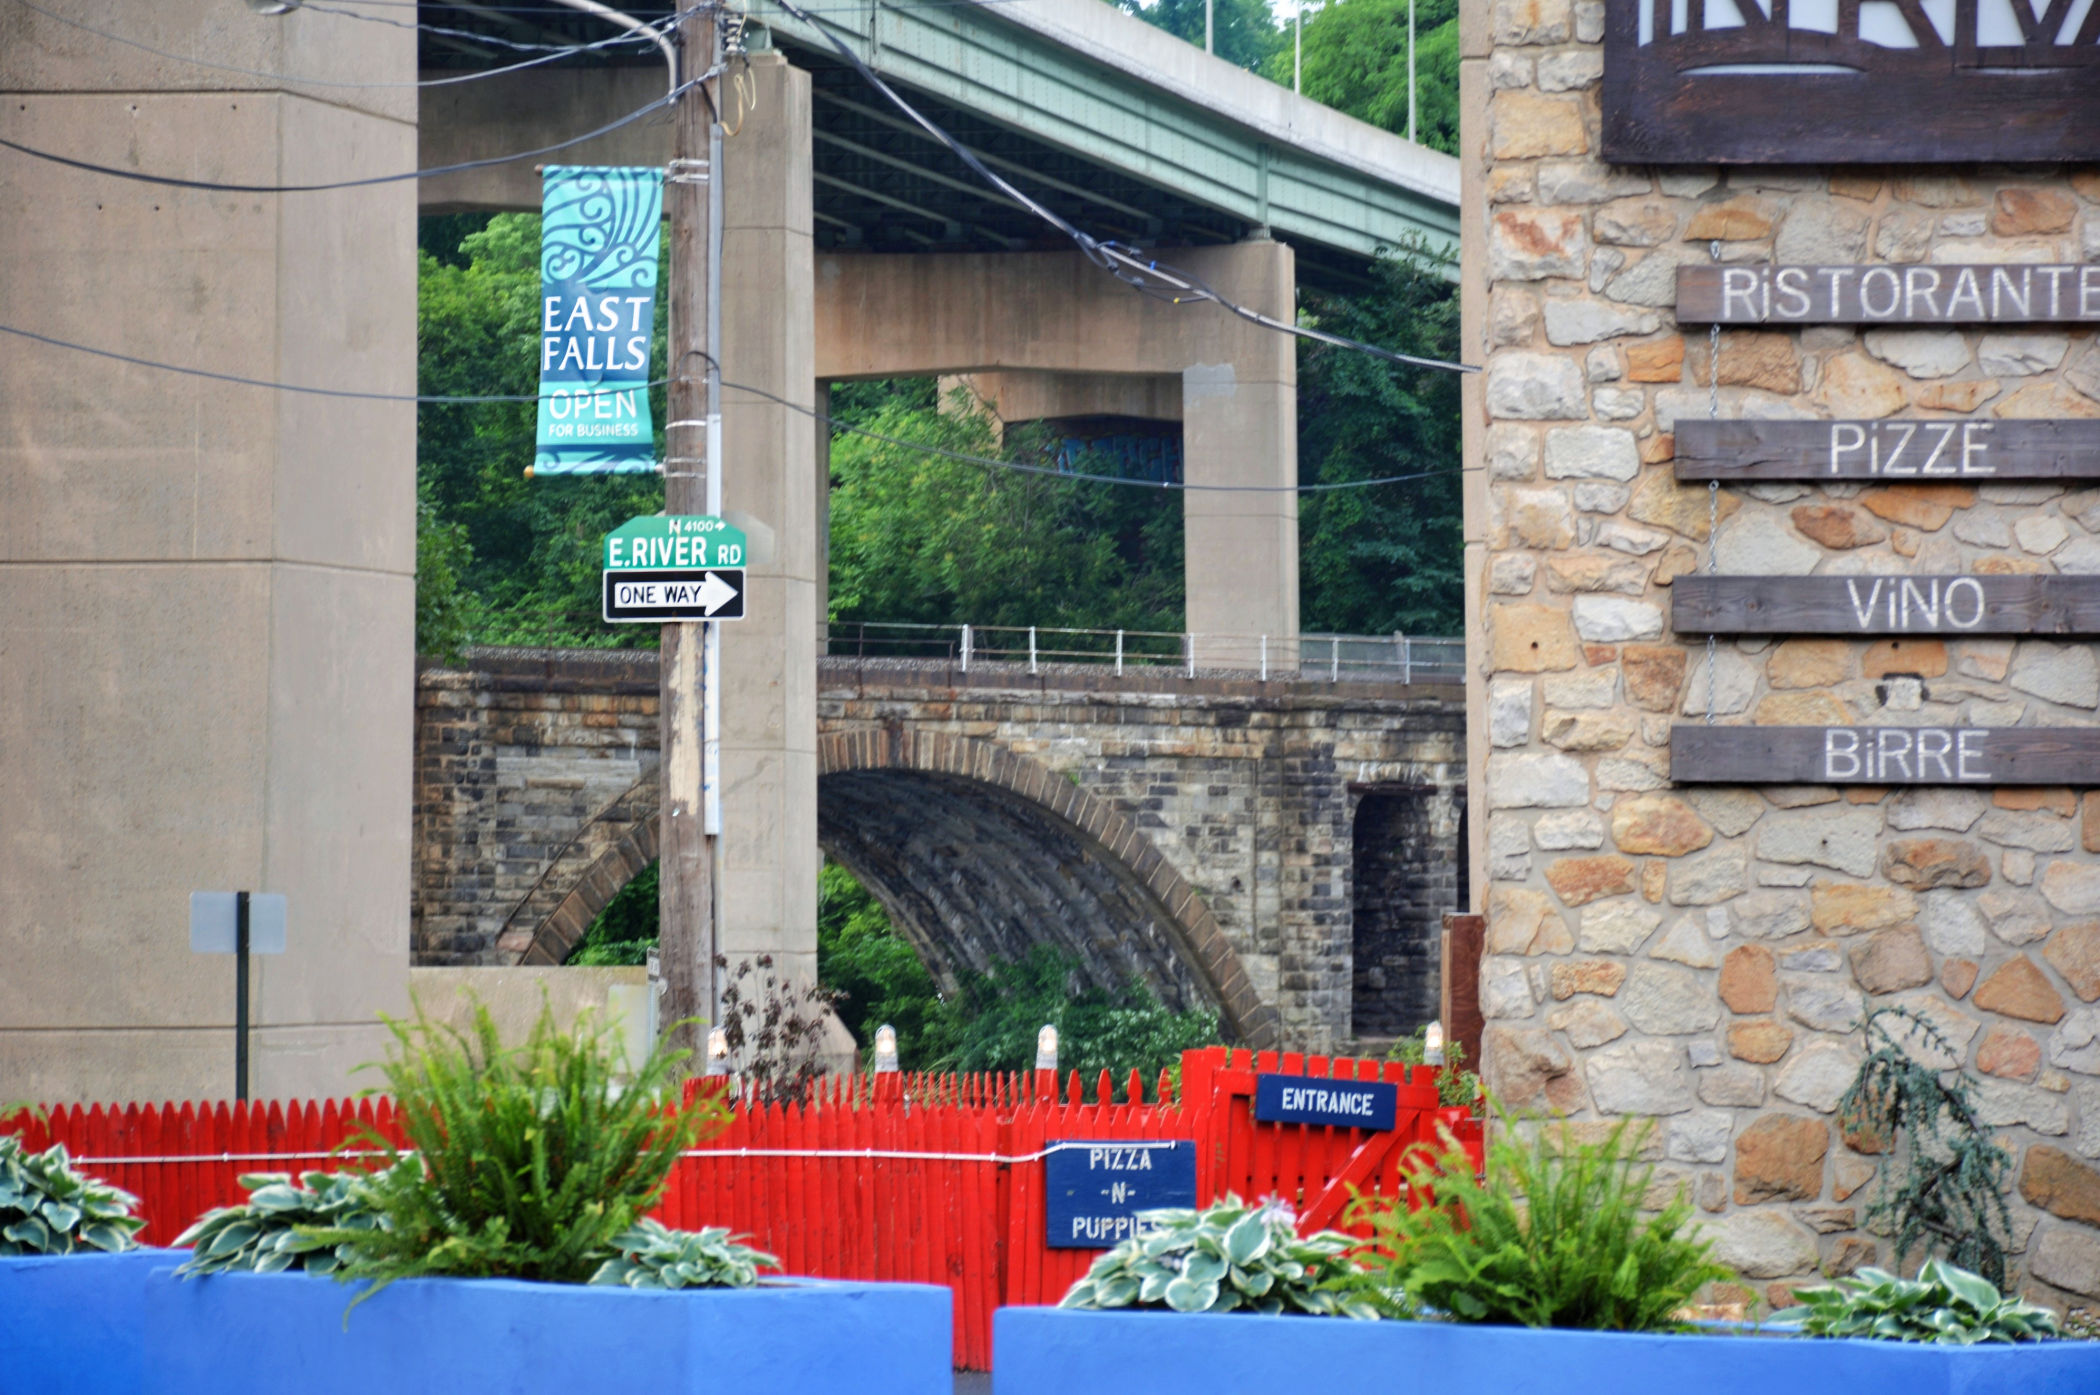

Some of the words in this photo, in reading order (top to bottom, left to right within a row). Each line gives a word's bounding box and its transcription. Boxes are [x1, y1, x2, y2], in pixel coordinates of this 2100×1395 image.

[544, 295, 651, 332] EAST
[543, 336, 647, 371] FALLS
[550, 388, 637, 419] OPEN
[548, 423, 574, 437] FOR
[577, 423, 638, 437] BUSINESS
[668, 518, 681, 535] N
[684, 520, 714, 532] 4100
[717, 544, 742, 565] RD
[620, 585, 656, 604] ONE
[664, 585, 702, 603] WAY
[1282, 1087, 1374, 1116] ENTRANCE
[1090, 1149, 1152, 1171] PIZZA
